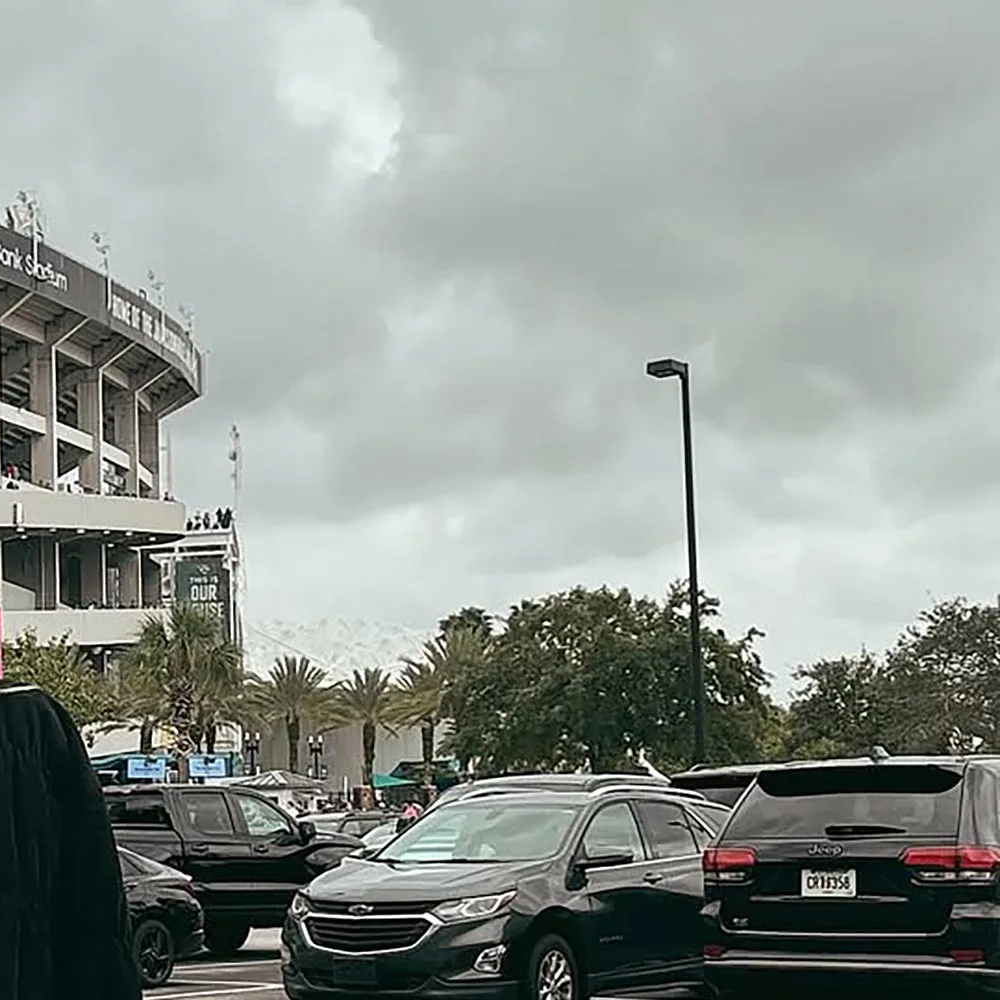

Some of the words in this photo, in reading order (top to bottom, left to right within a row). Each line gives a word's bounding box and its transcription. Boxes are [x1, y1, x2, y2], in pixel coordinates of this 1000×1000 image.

[25, 254, 67, 291] Sadium
[190, 584, 217, 601] OUR
[807, 843, 843, 857] Jeep
